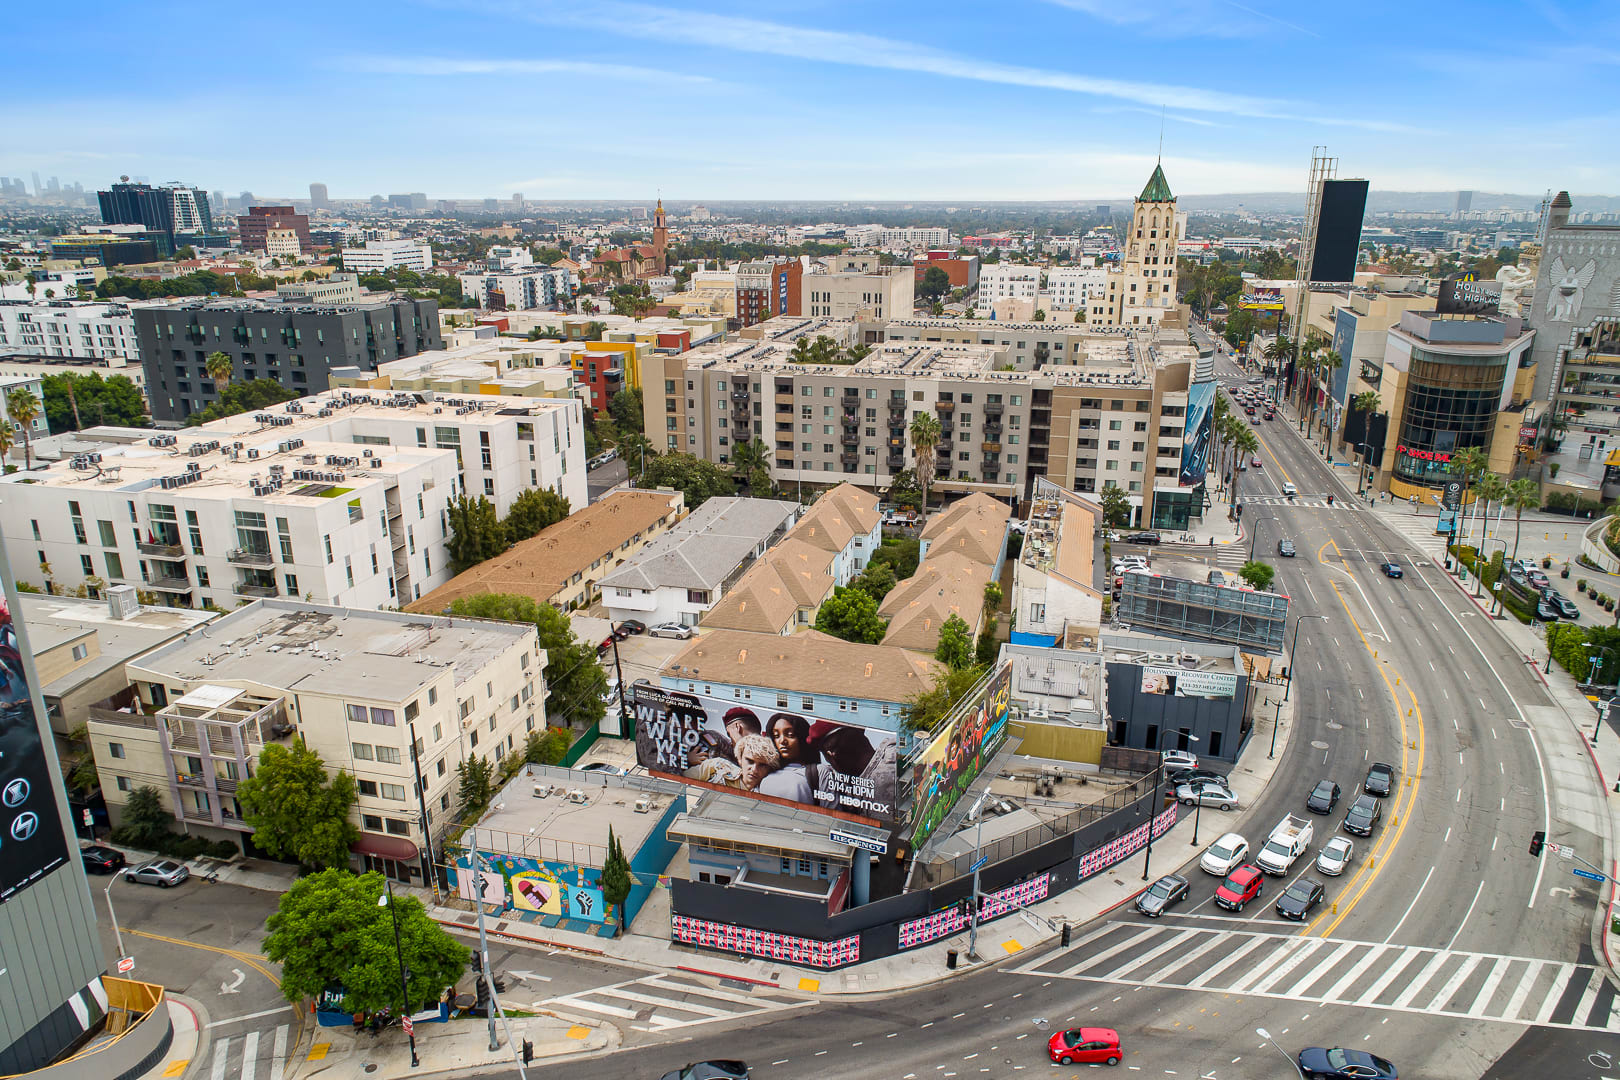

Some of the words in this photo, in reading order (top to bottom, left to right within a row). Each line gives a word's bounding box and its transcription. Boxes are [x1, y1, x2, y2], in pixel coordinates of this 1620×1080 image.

[1456, 281, 1500, 297] HOLLYWOOD
[1454, 292, 1460, 300] &
[1464, 293, 1500, 304] HIGHLAND
[1408, 448, 1433, 460] SHOE
[1144, 668, 1180, 676] HOLLYWOOD
[1181, 671, 1210, 679] RECOVERY
[637, 704, 666, 724] WE
[670, 712, 704, 731] ARE
[646, 722, 699, 746] WHO
[655, 738, 688, 757] WE
[657, 752, 688, 769] ARE
[835, 773, 850, 782] NEW
[851, 775, 874, 788] SERIES
[814, 790, 835, 801] HBO
[828, 780, 844, 792] 9/14
[853, 786, 874, 798] 10PM
